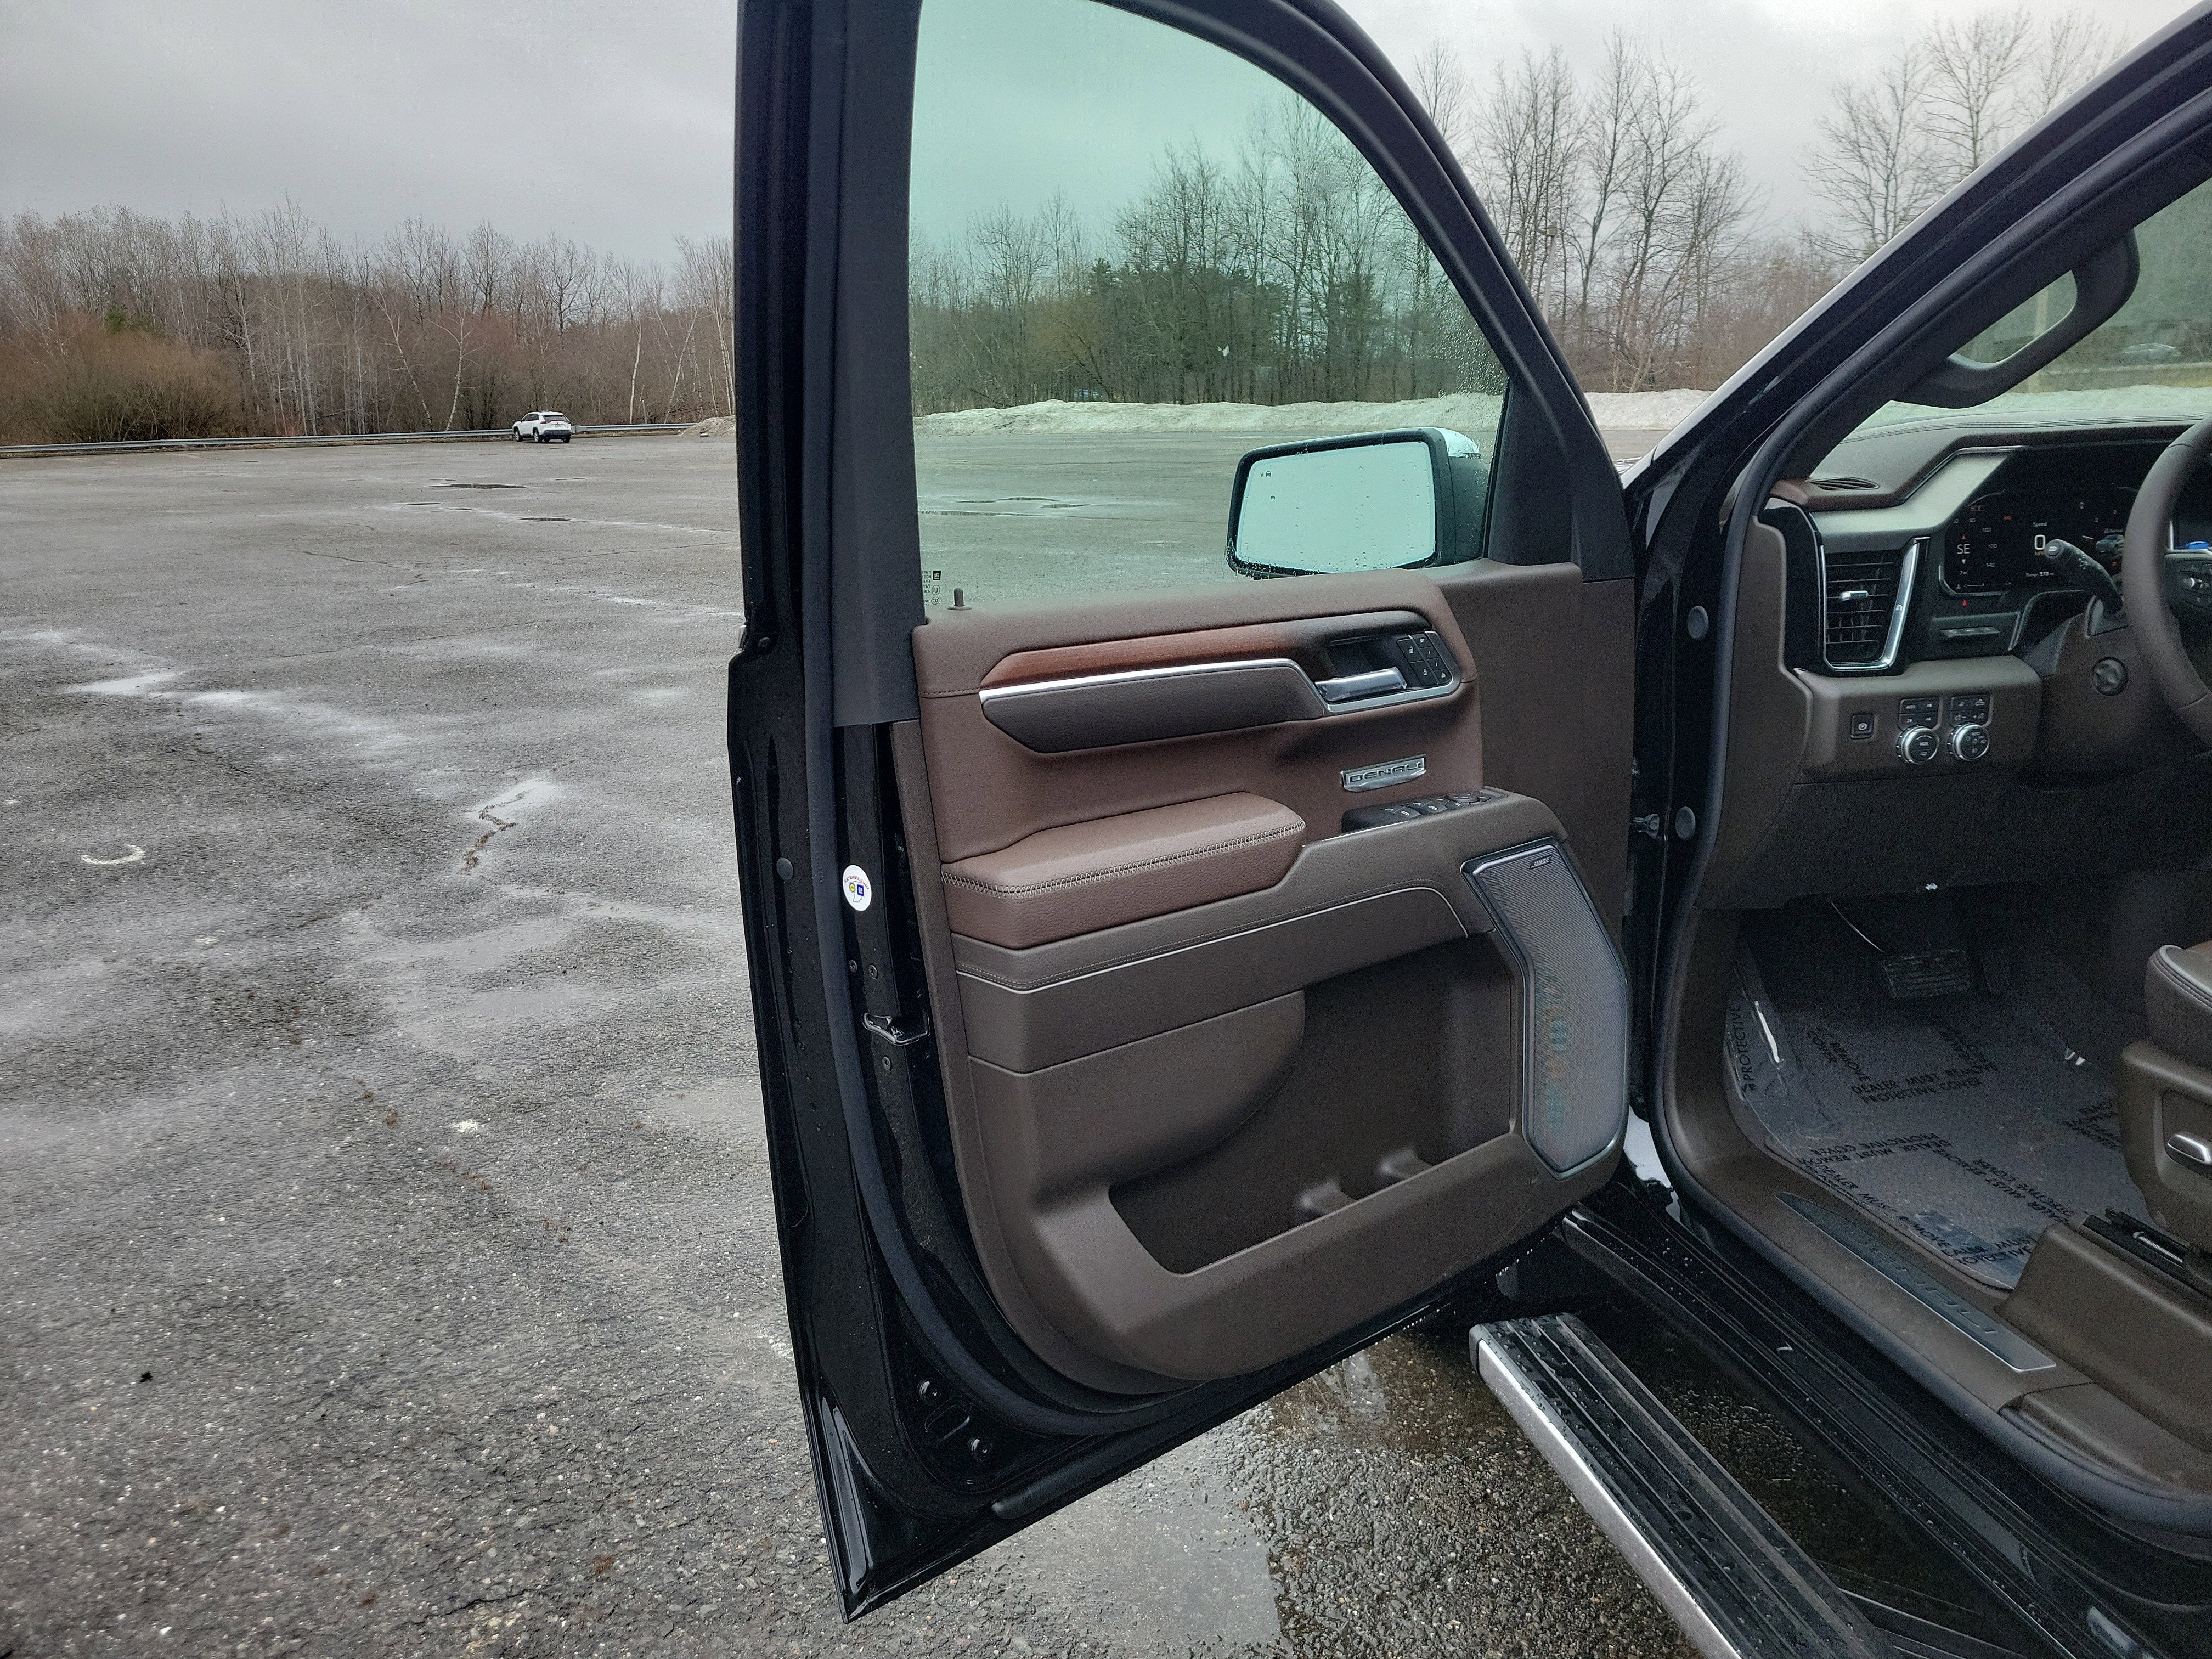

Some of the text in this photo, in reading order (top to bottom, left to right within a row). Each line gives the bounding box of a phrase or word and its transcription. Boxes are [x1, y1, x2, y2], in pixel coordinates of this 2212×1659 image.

[1957, 544, 1970, 554] SE
[2034, 534, 2046, 550] 0
[1349, 761, 1422, 784] DENALI
[1729, 1006, 1755, 1081] PROTECTIVE
[1852, 1063, 2000, 1094] DEALER MUST REMOVE
[1860, 1076, 1984, 1104] PROTECTIVE COVER
[2026, 1201, 2069, 1223] EALER
[1954, 1245, 2032, 1266] OTECTIVE
